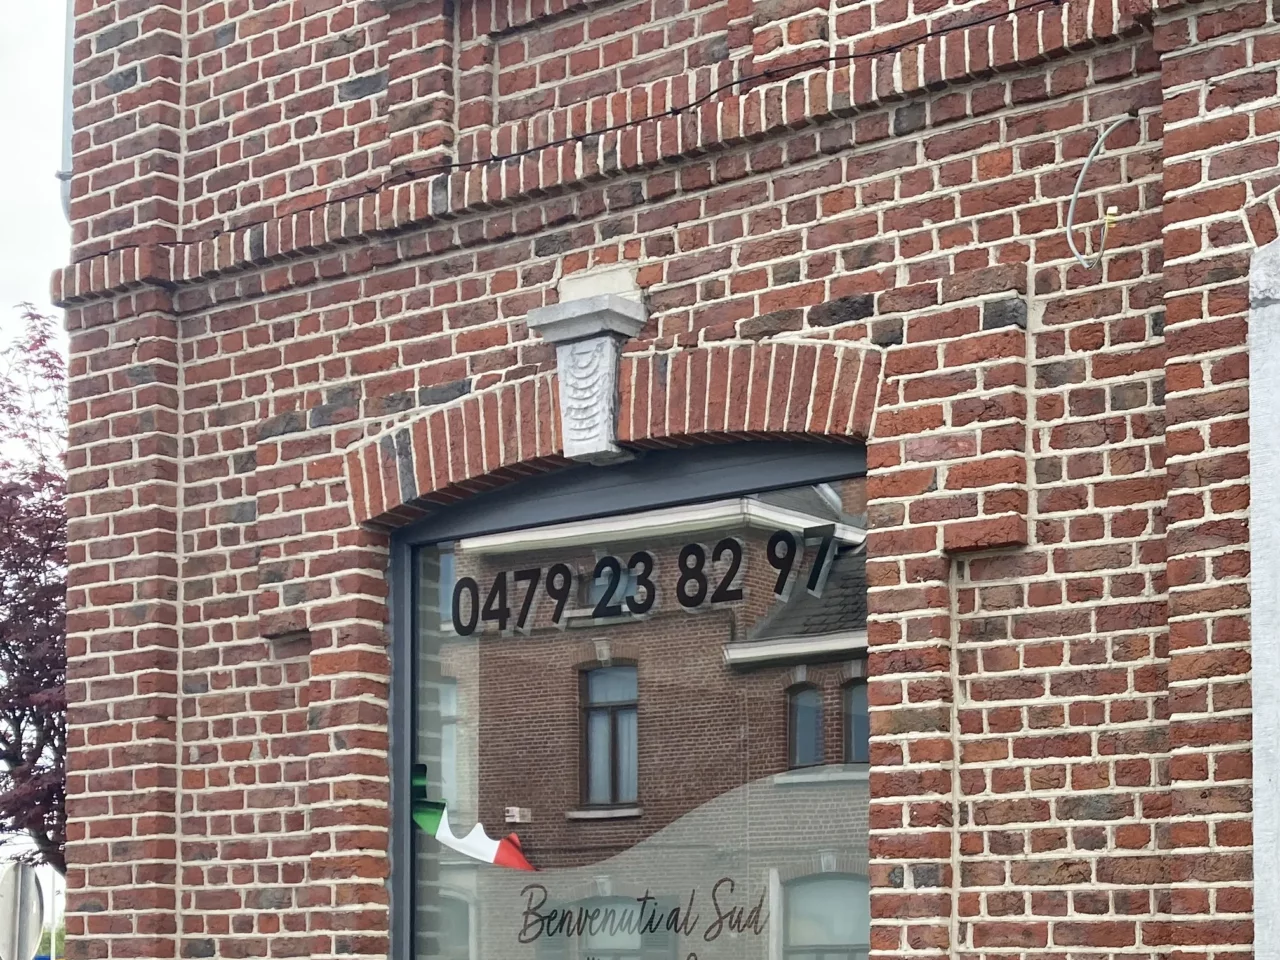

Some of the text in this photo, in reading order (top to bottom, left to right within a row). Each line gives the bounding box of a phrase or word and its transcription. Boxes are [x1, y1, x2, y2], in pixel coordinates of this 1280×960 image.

[452, 524, 835, 636] 0479 23 82 97
[518, 877, 770, 943] Benvenuti al Sud
